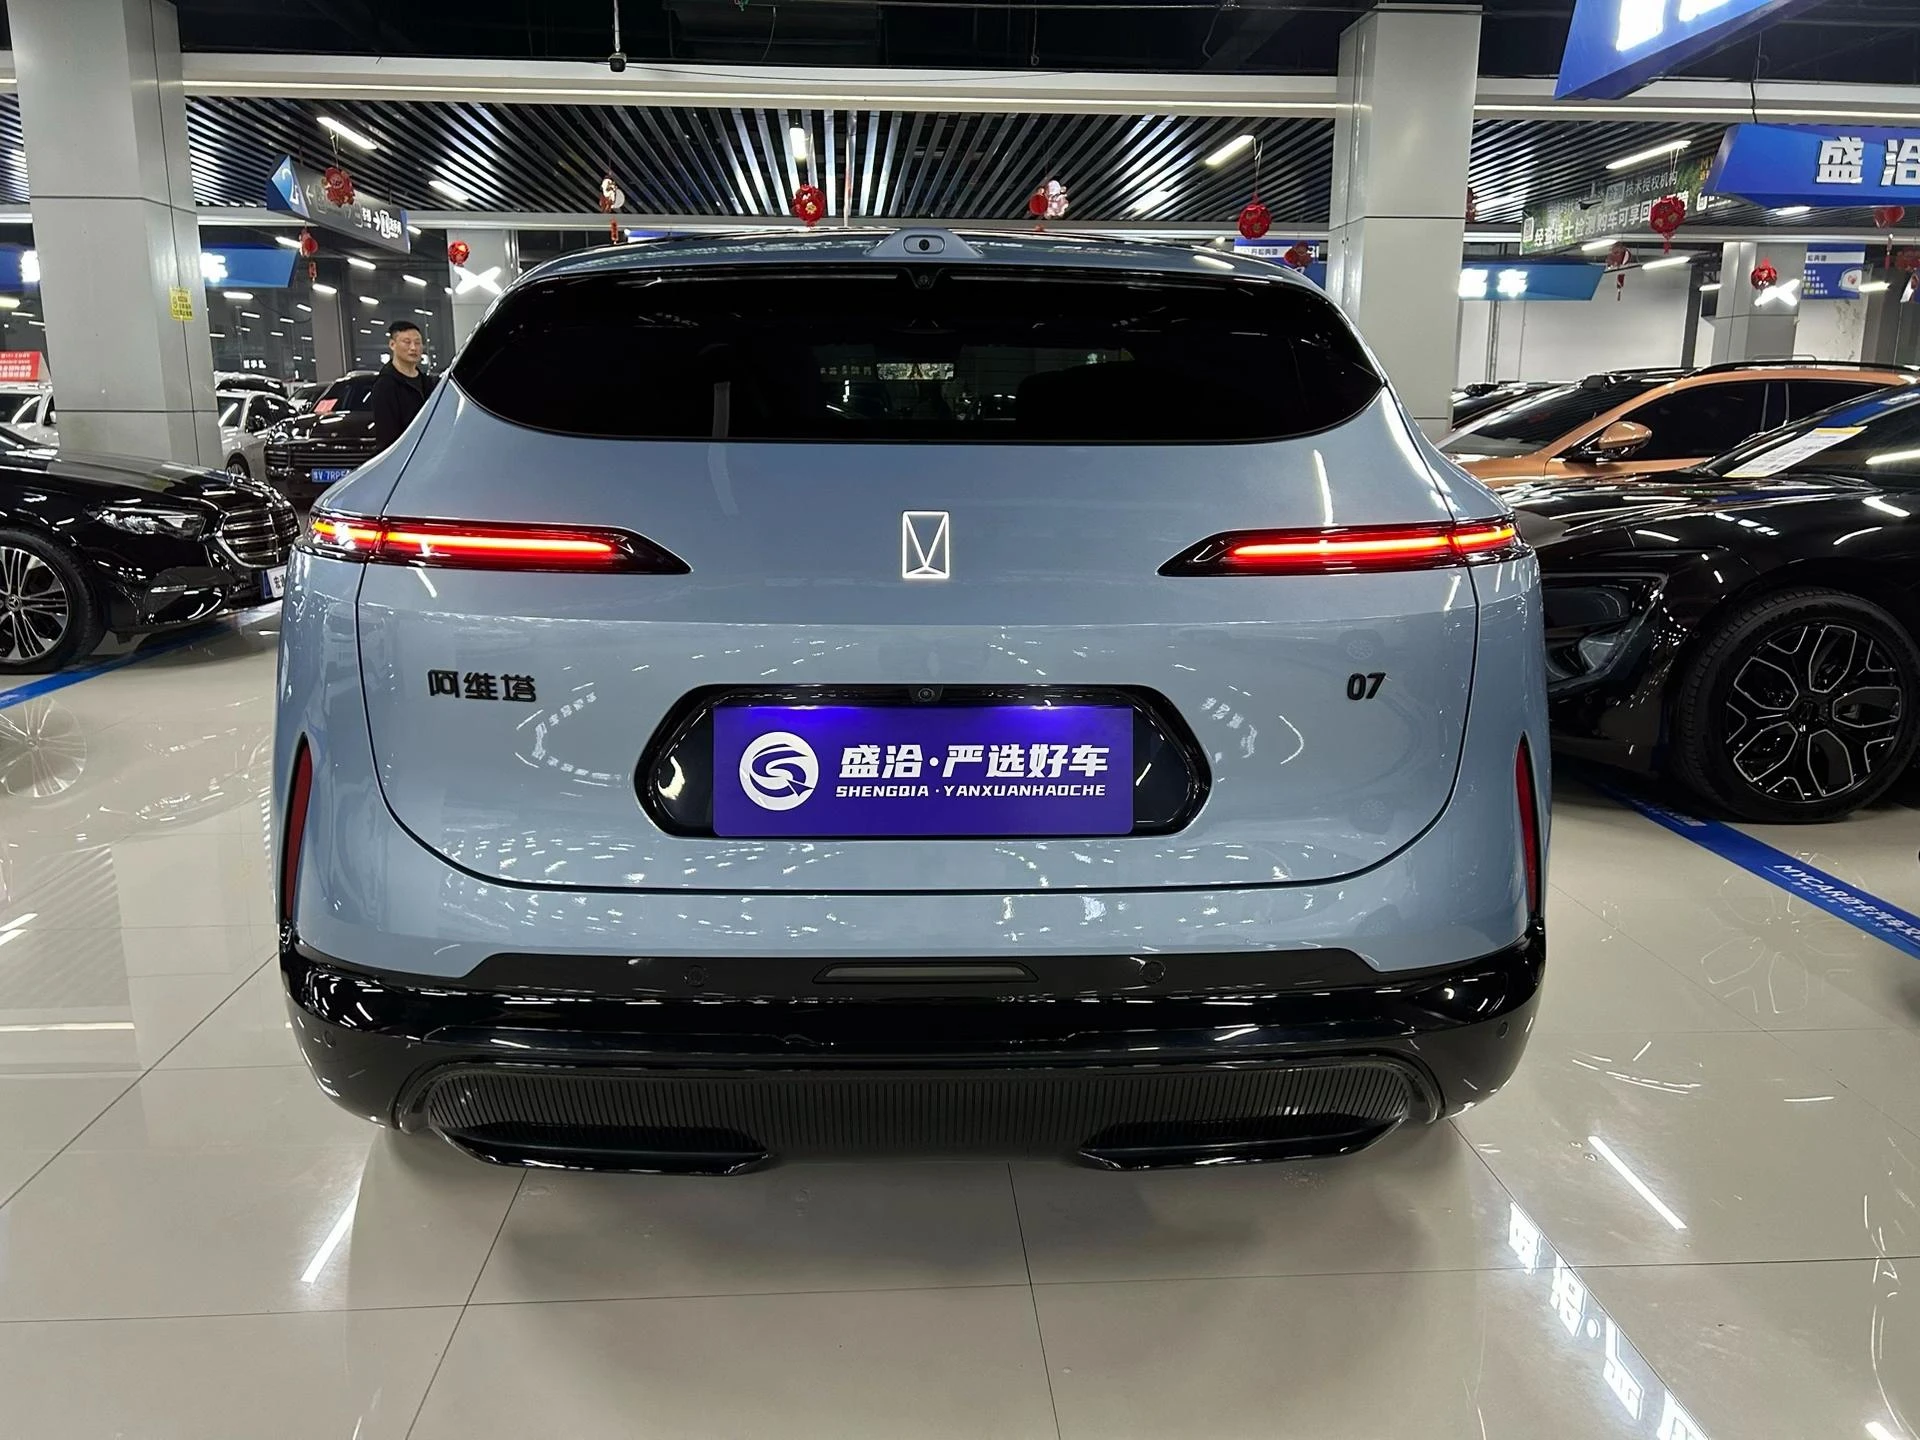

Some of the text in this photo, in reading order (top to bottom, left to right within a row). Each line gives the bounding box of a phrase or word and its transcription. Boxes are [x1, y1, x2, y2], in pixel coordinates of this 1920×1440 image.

[427, 669, 537, 703] 阿维塔
[1346, 671, 1387, 701] 07
[838, 743, 1110, 779] 盛洽·严选好车
